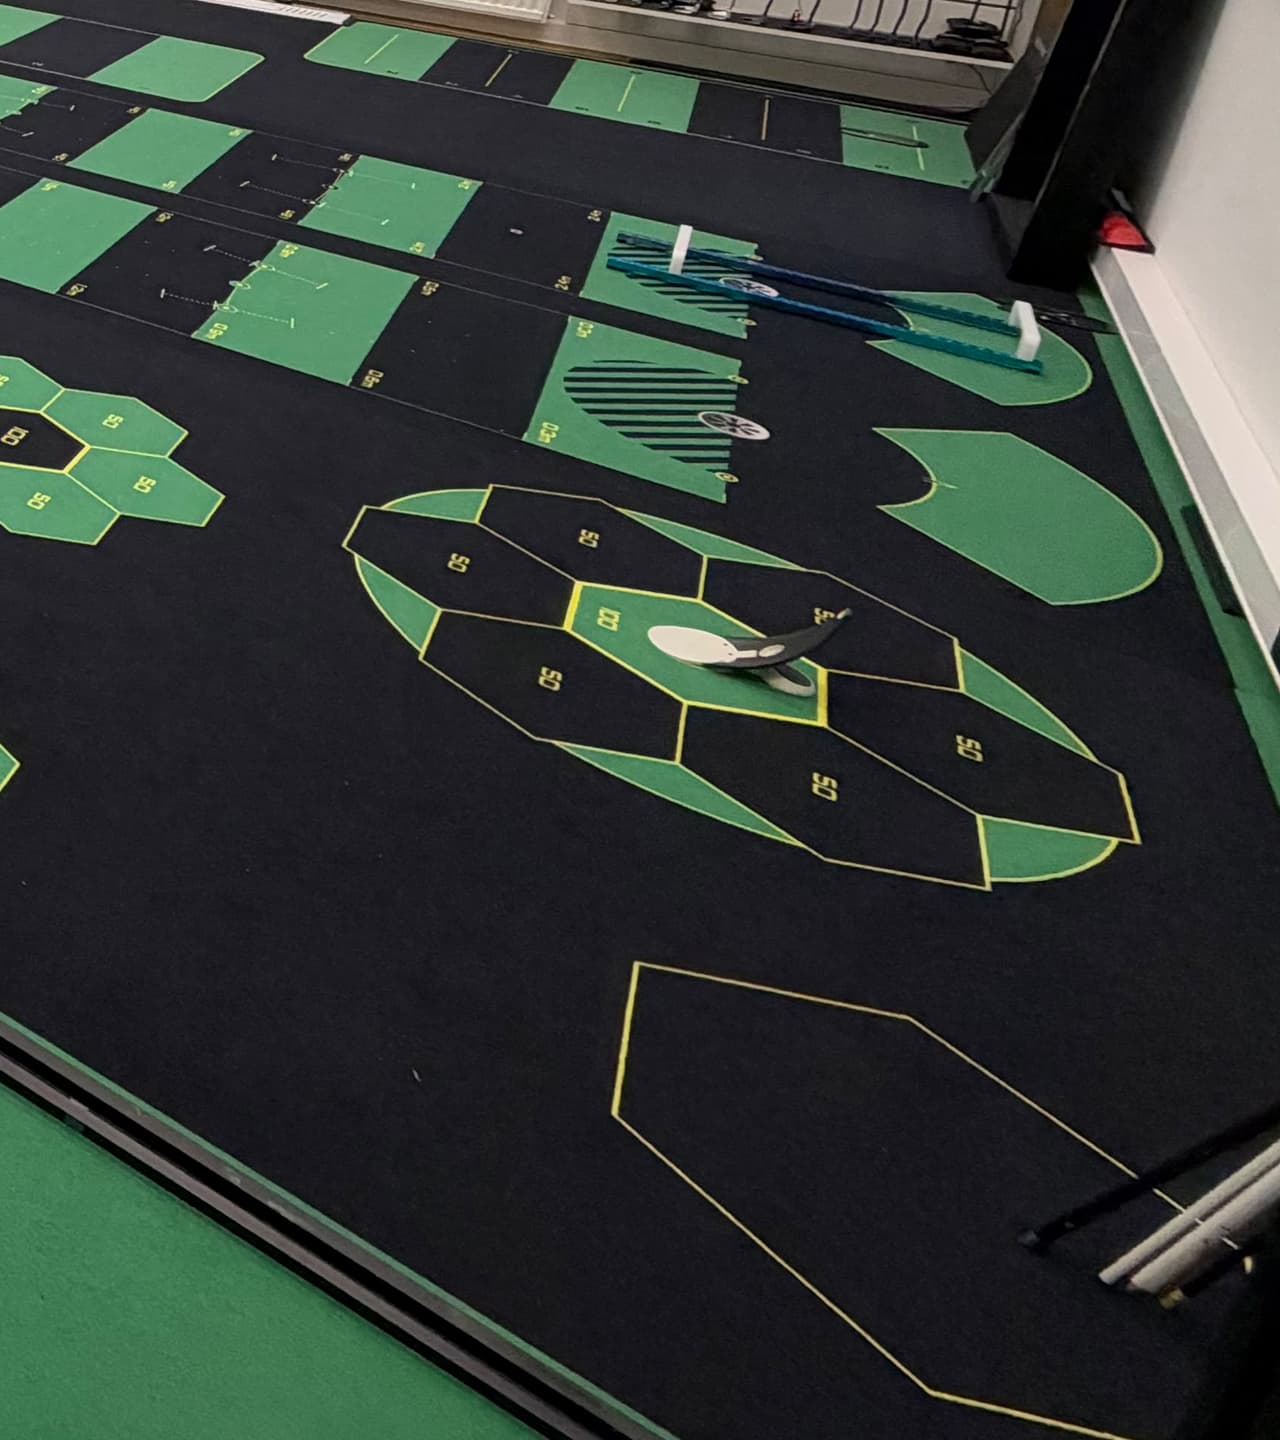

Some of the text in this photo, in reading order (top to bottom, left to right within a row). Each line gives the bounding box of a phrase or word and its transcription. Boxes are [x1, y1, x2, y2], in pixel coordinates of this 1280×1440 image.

[102, 414, 123, 428] 50
[1, 426, 28, 445] 100
[133, 476, 156, 493] 50
[27, 492, 51, 509] 50
[579, 529, 599, 547] 50
[448, 553, 470, 572] 50
[597, 607, 620, 631] 100
[539, 667, 562, 691] 50
[956, 735, 982, 761] 50
[812, 773, 837, 801] 50
